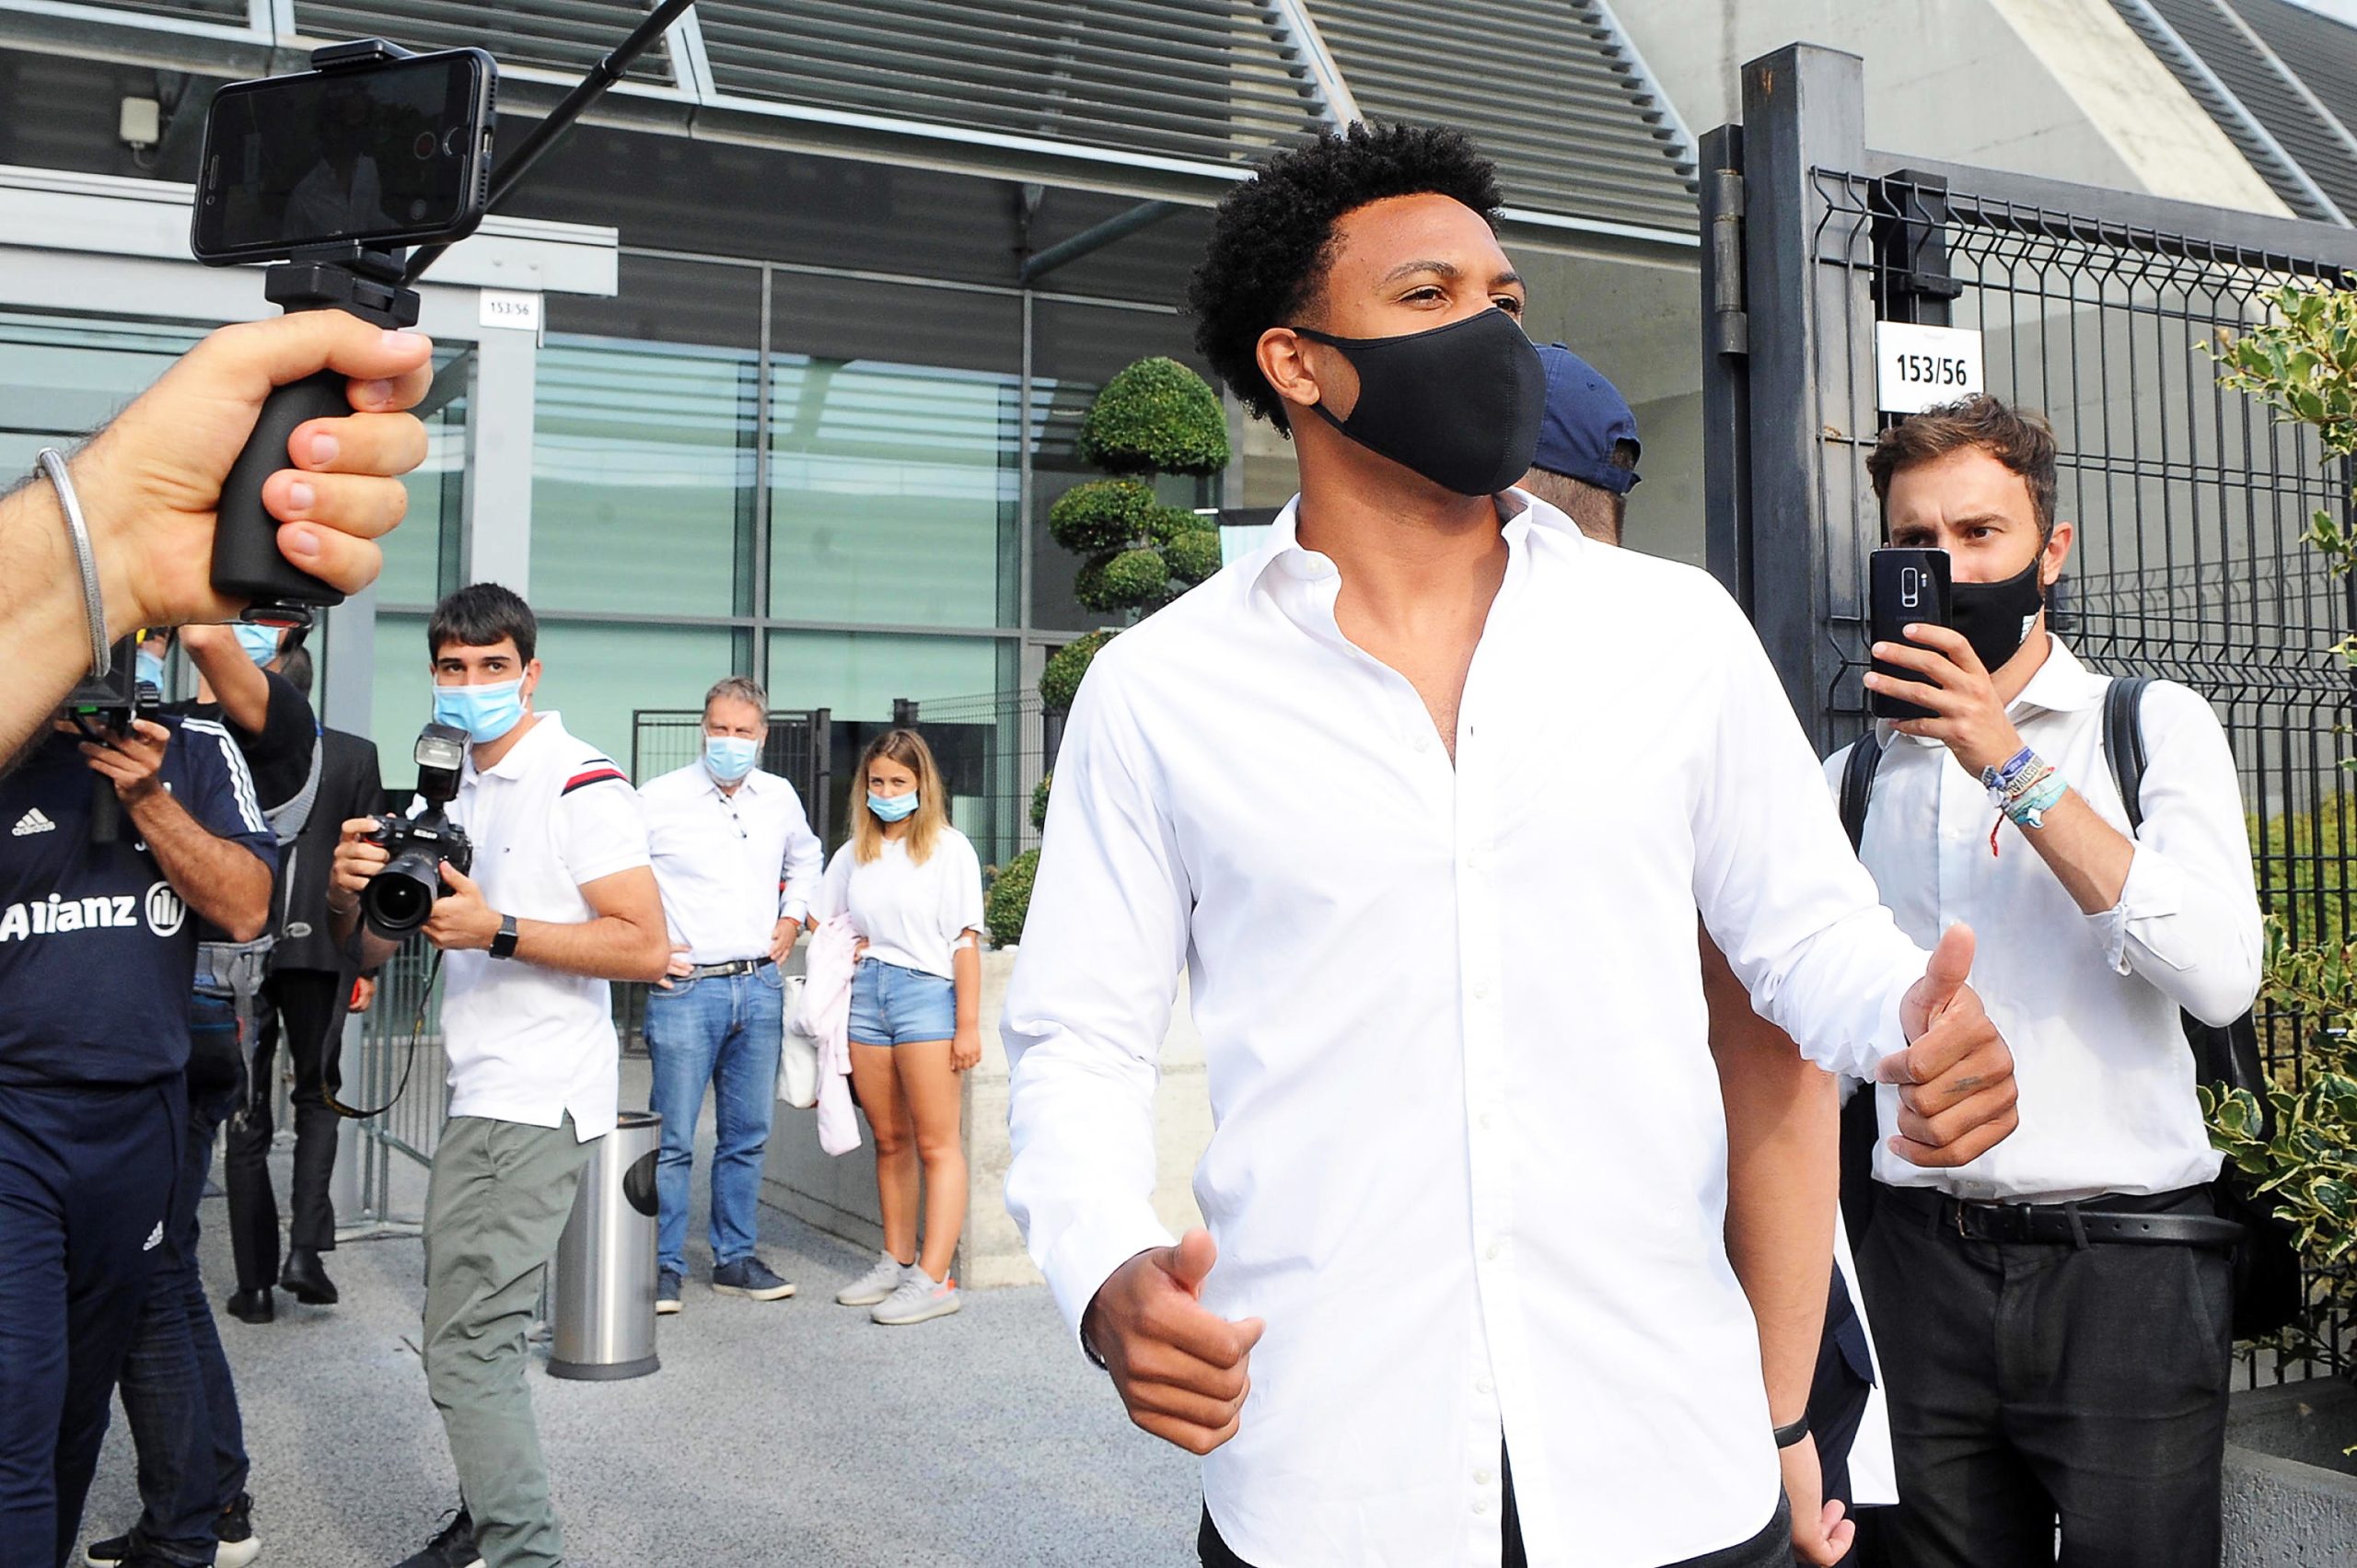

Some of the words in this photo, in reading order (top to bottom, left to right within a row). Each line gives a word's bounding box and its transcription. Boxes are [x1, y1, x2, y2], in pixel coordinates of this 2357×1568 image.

[491, 302, 529, 315] 153/56
[1897, 354, 1967, 386] 153/56
[0, 892, 138, 942] Alianz
